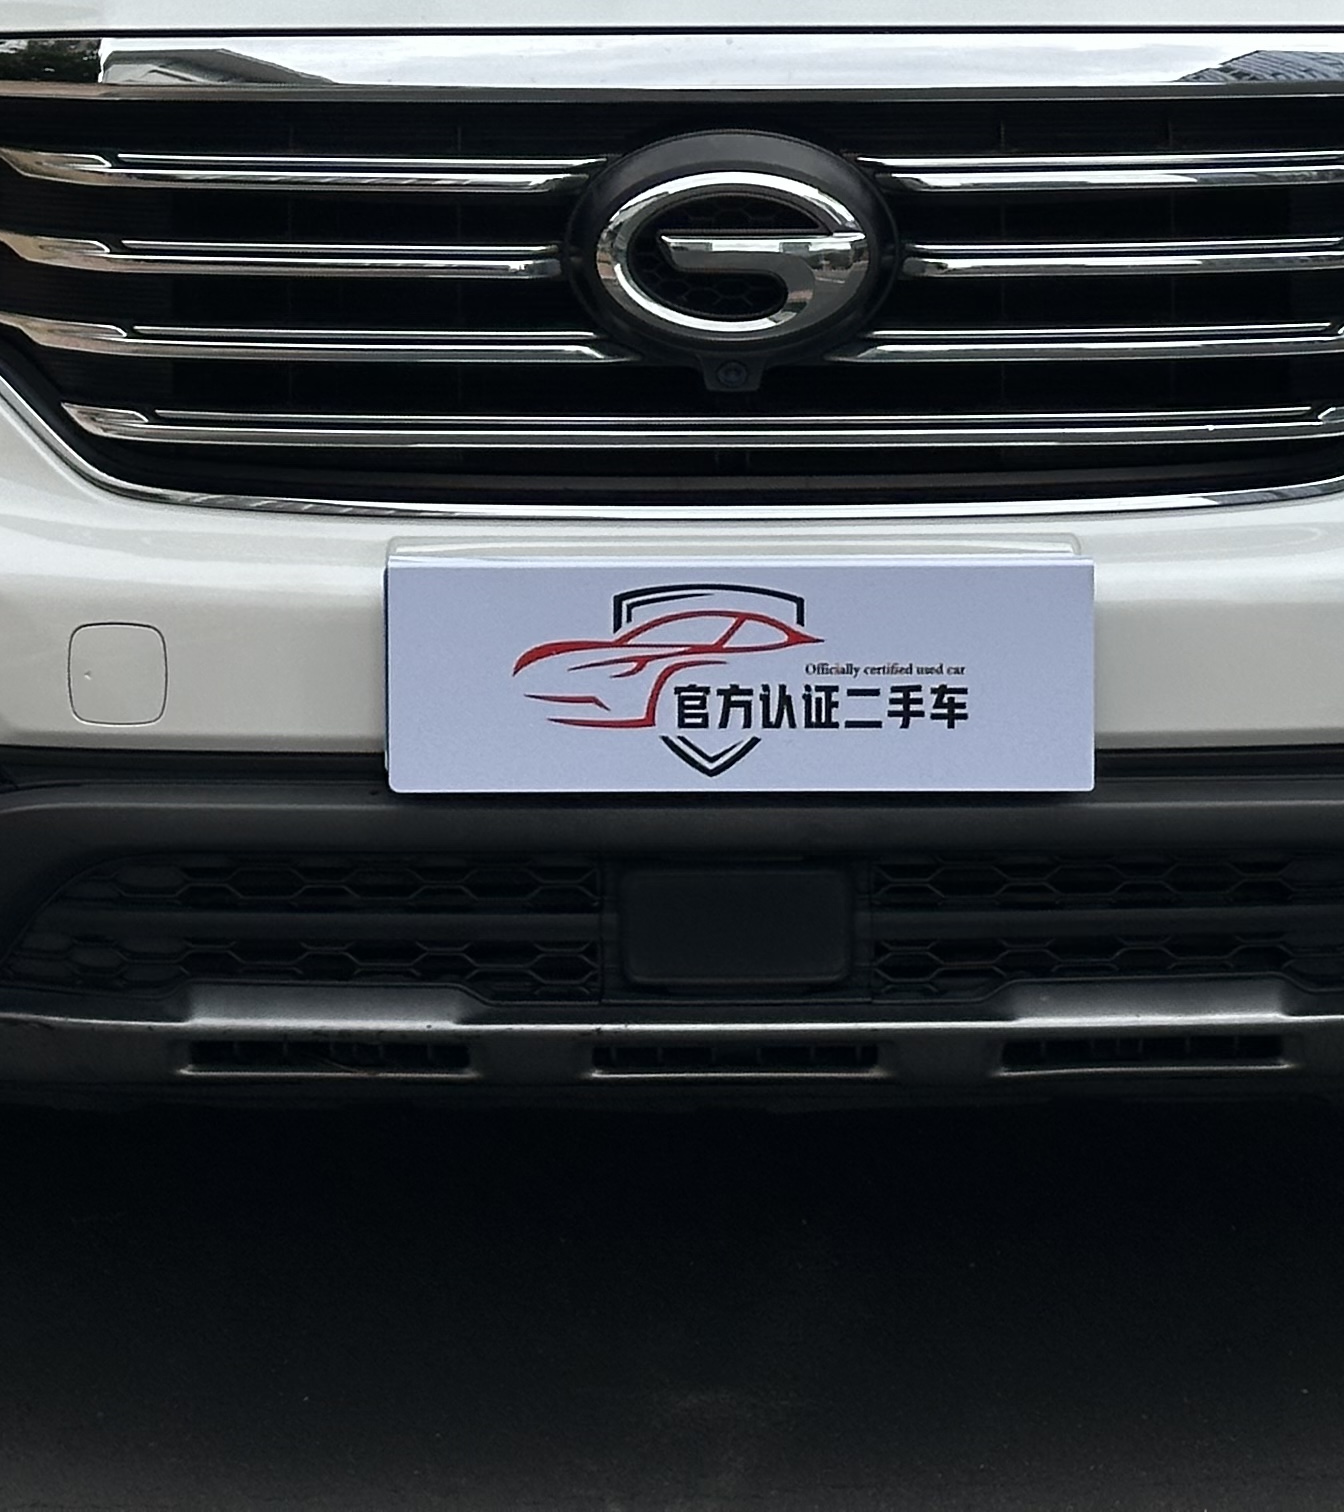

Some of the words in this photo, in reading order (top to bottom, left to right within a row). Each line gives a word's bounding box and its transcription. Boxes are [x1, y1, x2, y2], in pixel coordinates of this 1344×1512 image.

[805, 663, 860, 678] Officially
[863, 663, 913, 676] certified
[916, 663, 944, 676] used
[946, 666, 966, 676] car
[674, 683, 969, 729] 官方认证二手车
